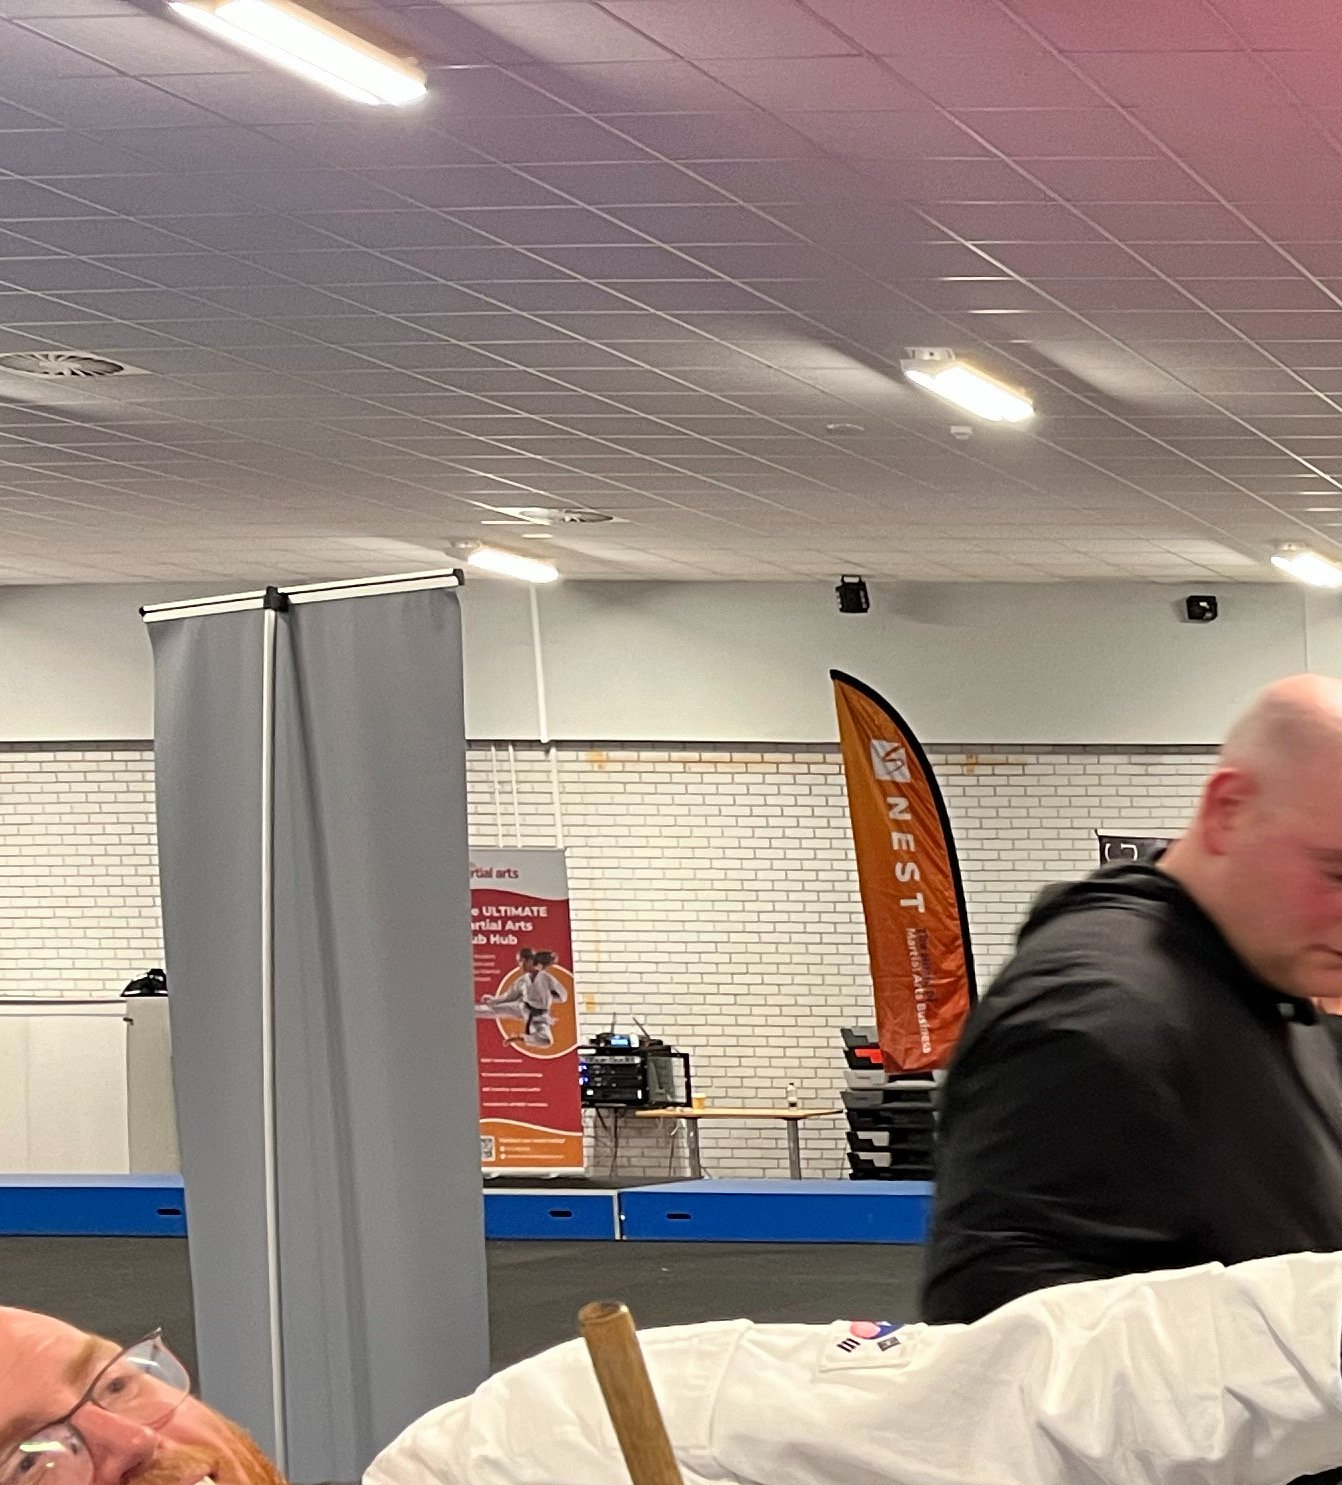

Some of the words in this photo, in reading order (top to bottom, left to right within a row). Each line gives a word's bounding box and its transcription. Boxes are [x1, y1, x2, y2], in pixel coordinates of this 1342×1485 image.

[886, 796, 926, 914] NEST
[496, 868, 519, 879] arts
[482, 906, 548, 917] ULTIMATE
[505, 920, 533, 931] Arts
[490, 934, 518, 945] Hub
[906, 928, 922, 972] Martial
[912, 974, 925, 1001] Arts
